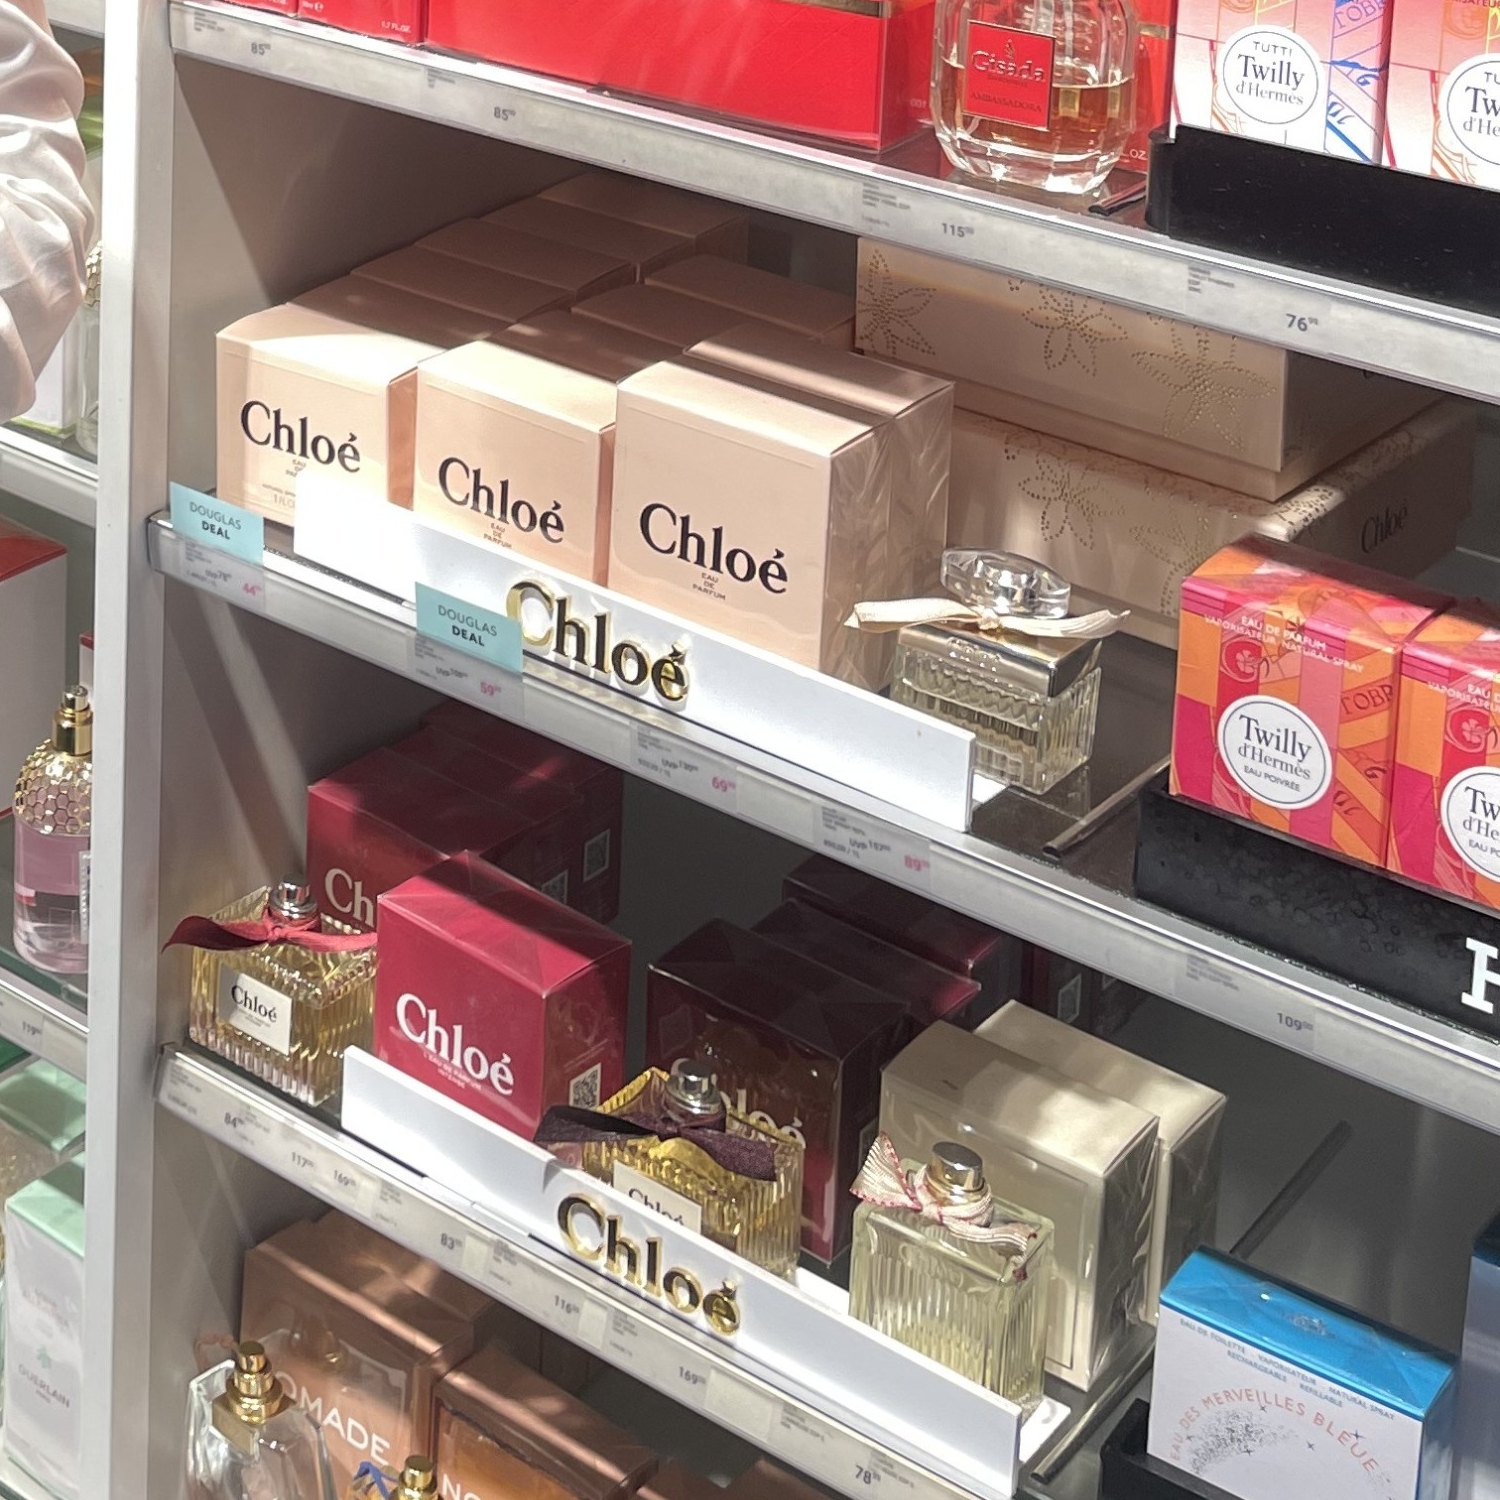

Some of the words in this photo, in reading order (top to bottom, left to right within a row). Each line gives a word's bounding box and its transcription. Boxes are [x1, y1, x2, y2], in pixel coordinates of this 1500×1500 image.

[972, 50, 1045, 82] Gisada
[1253, 41, 1292, 56] TUTTI
[1237, 53, 1305, 92] Twilly
[241, 400, 360, 473] Chloé
[190, 502, 242, 531] DOUGLAS
[438, 457, 564, 544] Chloé
[202, 521, 230, 540] DEAL
[640, 503, 788, 594] Chloé
[693, 584, 726, 601] PARFUM
[702, 572, 718, 583] EAU
[703, 580, 715, 589] DE
[438, 604, 498, 638] DOUGLAS
[452, 625, 485, 647] DEAL
[1241, 615, 1263, 631] EAU
[1265, 623, 1280, 636] DE
[1283, 628, 1327, 650] PARFUM
[506, 577, 689, 701] Chloé
[1468, 683, 1491, 699] EAU
[1239, 714, 1312, 762] Twilly
[1238, 743, 1311, 780] d'Hermès
[1244, 765, 1262, 780] EAU
[1264, 770, 1301, 792] POIVRÉE
[231, 984, 278, 1023] Chloé
[396, 993, 515, 1096] Chloé
[558, 1193, 741, 1336] Chloé
[1171, 1436, 1184, 1461] EAU
[1180, 1406, 1200, 1430] DES
[1202, 1388, 1306, 1417] MERVEILLES
[1313, 1411, 1379, 1472] BLEUE
